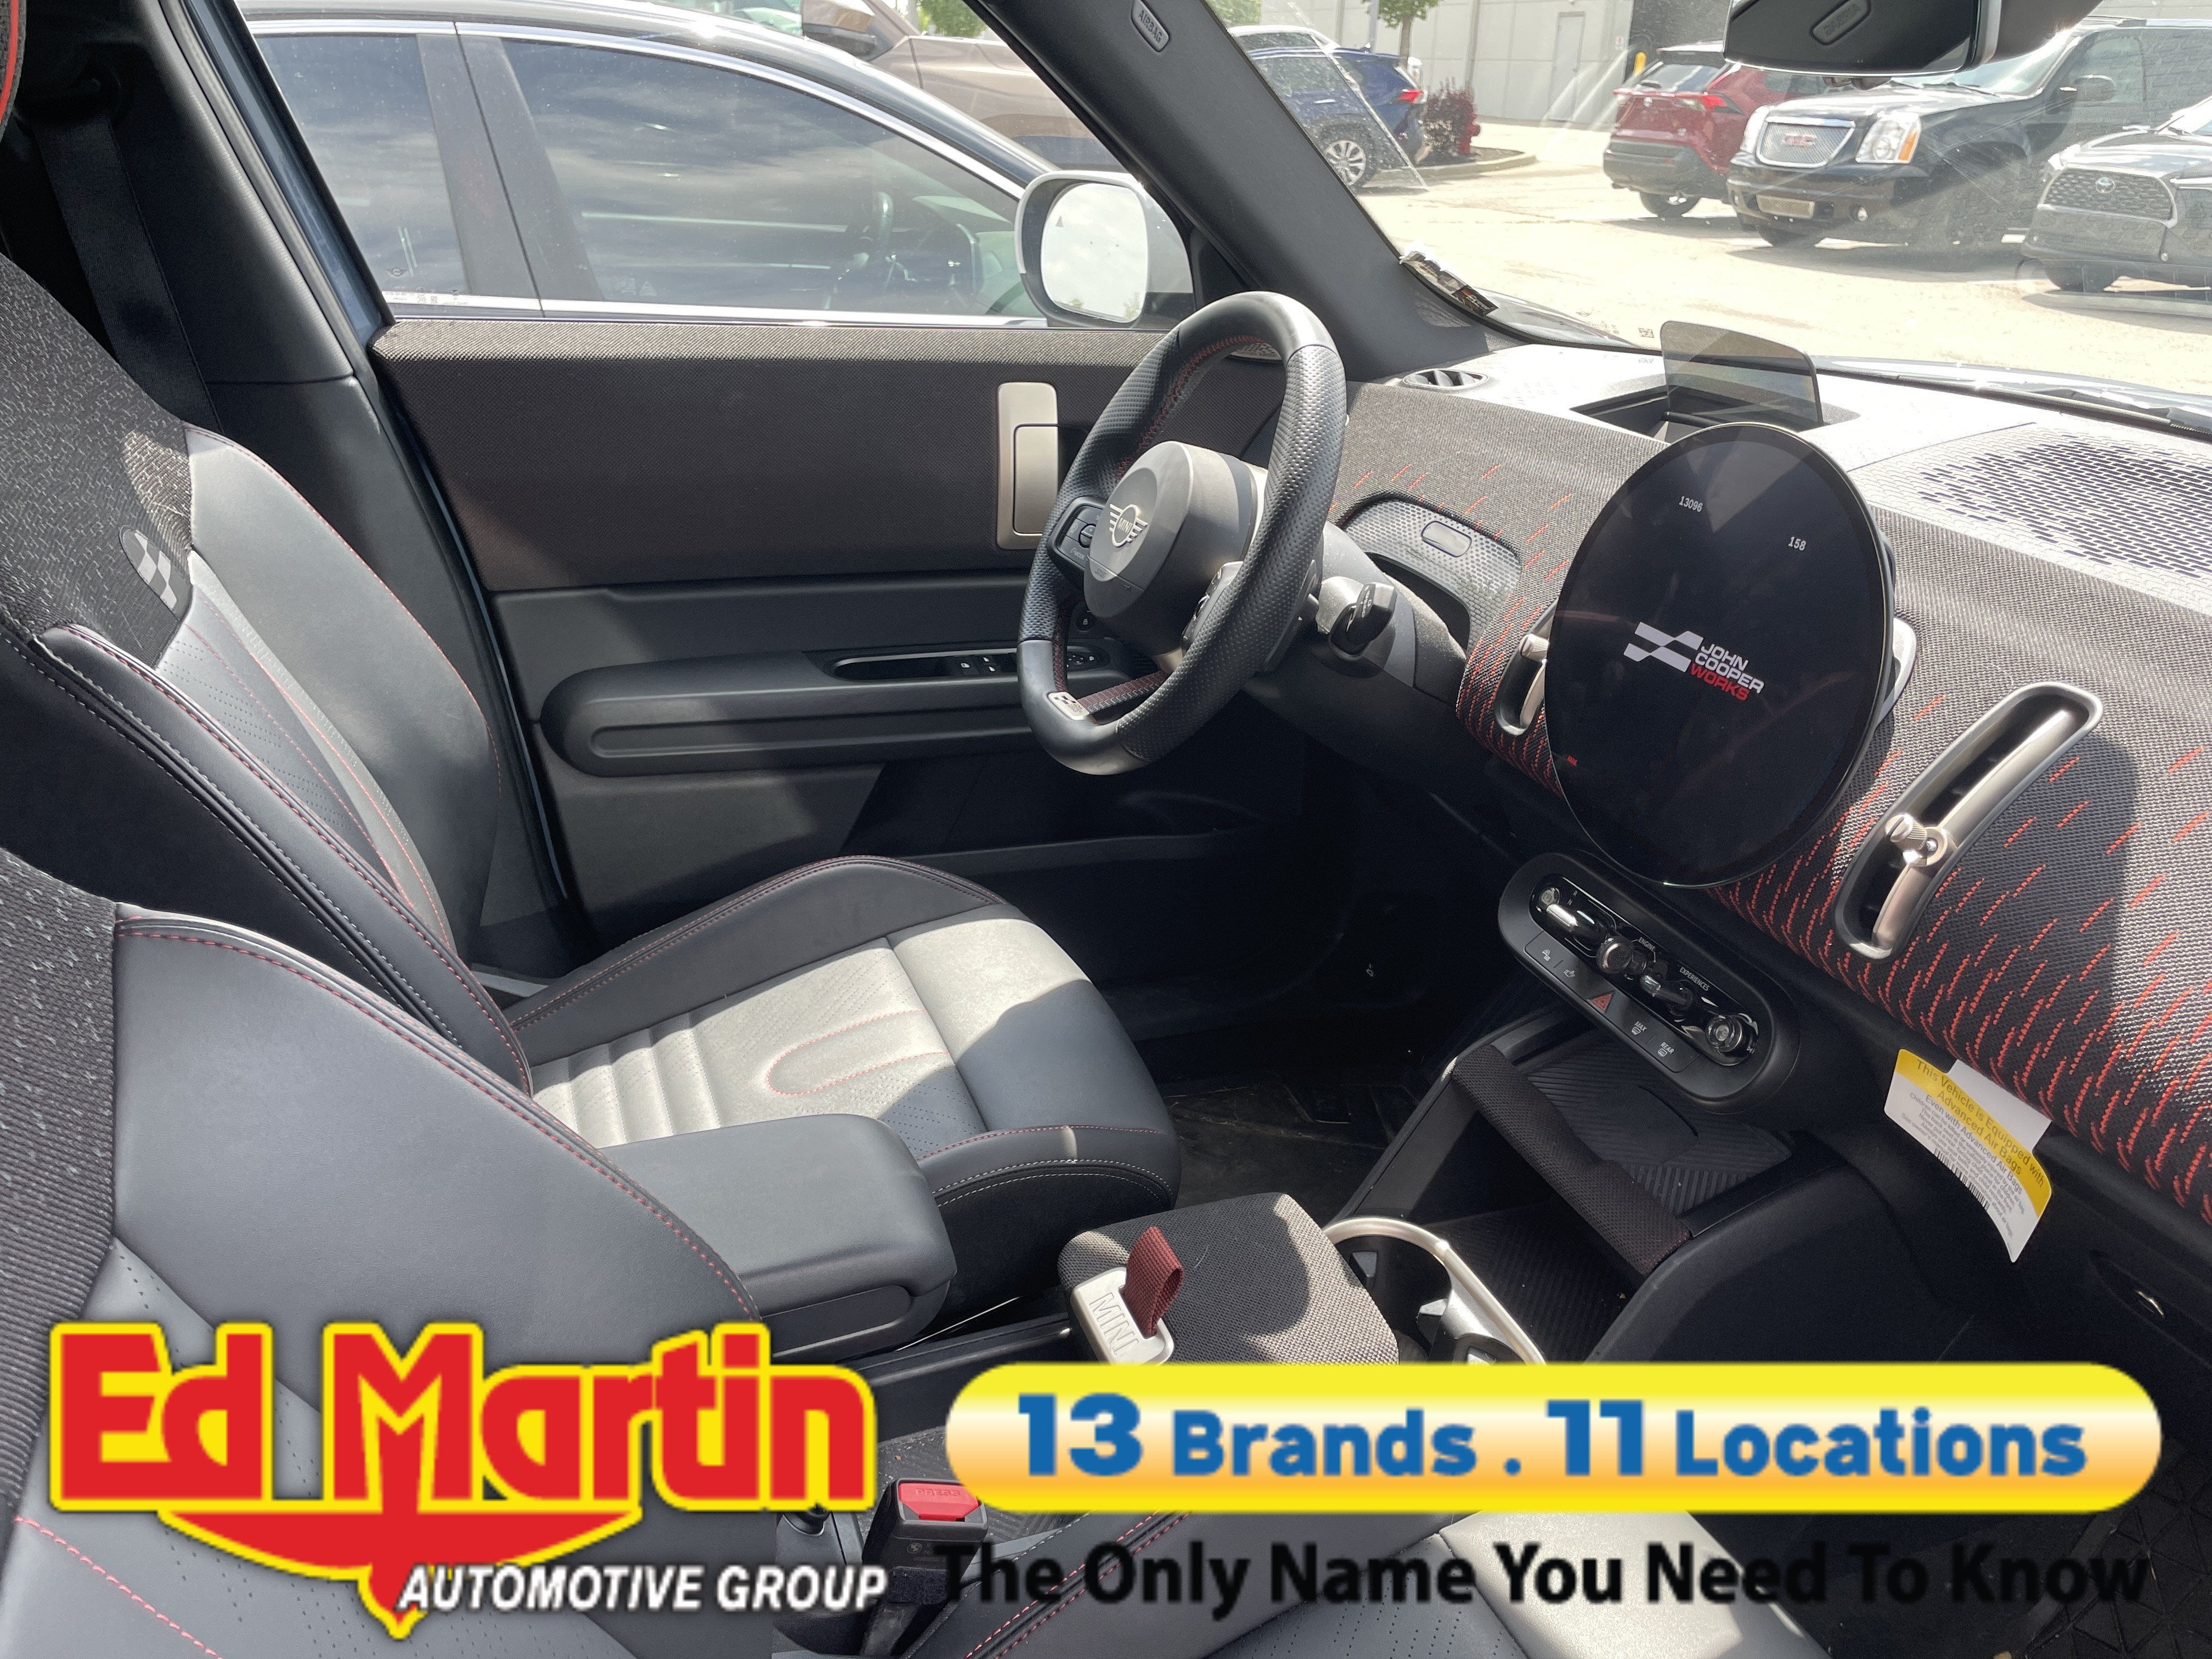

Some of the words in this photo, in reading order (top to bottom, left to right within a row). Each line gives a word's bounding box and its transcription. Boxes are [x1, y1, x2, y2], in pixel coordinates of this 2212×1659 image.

[1138, 10, 1163, 43] AIRBAG
[1679, 496, 1703, 512] 13096
[1788, 536, 1807, 551] 158
[1701, 644, 1749, 671] JOHN
[1690, 663, 1750, 701] WORKS
[1695, 652, 1765, 693] COOPER
[1638, 936, 1656, 952] ENGINE
[1679, 967, 1710, 991] EXPERIENCES
[1634, 1021, 1647, 1032] MAX
[1660, 1042, 1674, 1054] REAR
[1916, 1059, 1939, 1081] This
[1940, 1075, 1974, 1113] Vehicle
[1975, 1107, 1984, 1121] is
[1985, 1116, 2031, 1166] Equipped
[2029, 1162, 2045, 1188] with
[1937, 1091, 1984, 1136] Advanced
[1984, 1132, 1999, 1150] Air
[1999, 1146, 2022, 1175] Bags
[1926, 1093, 1944, 1115] Even
[1945, 1112, 1961, 1130] with
[1960, 1126, 1997, 1163] Advanced
[1996, 1160, 2007, 1174] Air
[2007, 1171, 2023, 1195] Bags
[1088, 1291, 1139, 1356] MINI
[914, 1488, 961, 1497] PRESS
